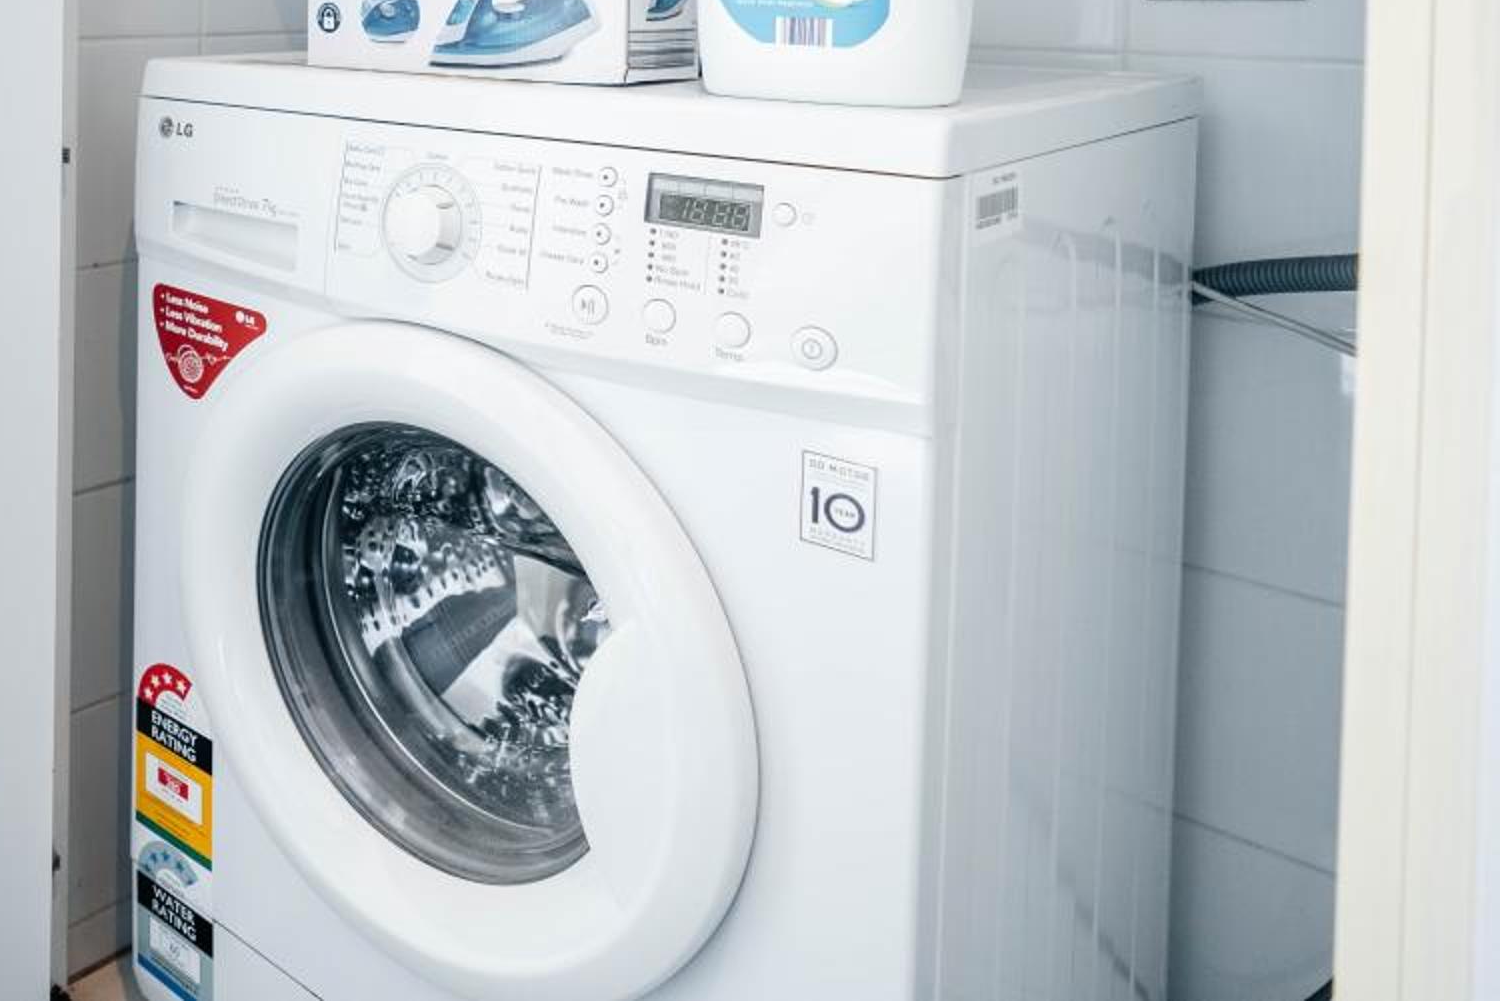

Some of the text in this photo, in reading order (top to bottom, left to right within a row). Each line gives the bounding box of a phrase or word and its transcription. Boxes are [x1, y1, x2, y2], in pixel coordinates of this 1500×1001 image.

[176, 123, 193, 138] LG
[166, 293, 209, 313] Less Noise
[166, 307, 223, 332] Less Vibration
[166, 321, 229, 351] More Durability
[810, 486, 865, 533] 10
[151, 710, 198, 747] ENERGY
[151, 725, 197, 762] RATING
[151, 884, 195, 925] WATER
[151, 899, 197, 942] RATING
